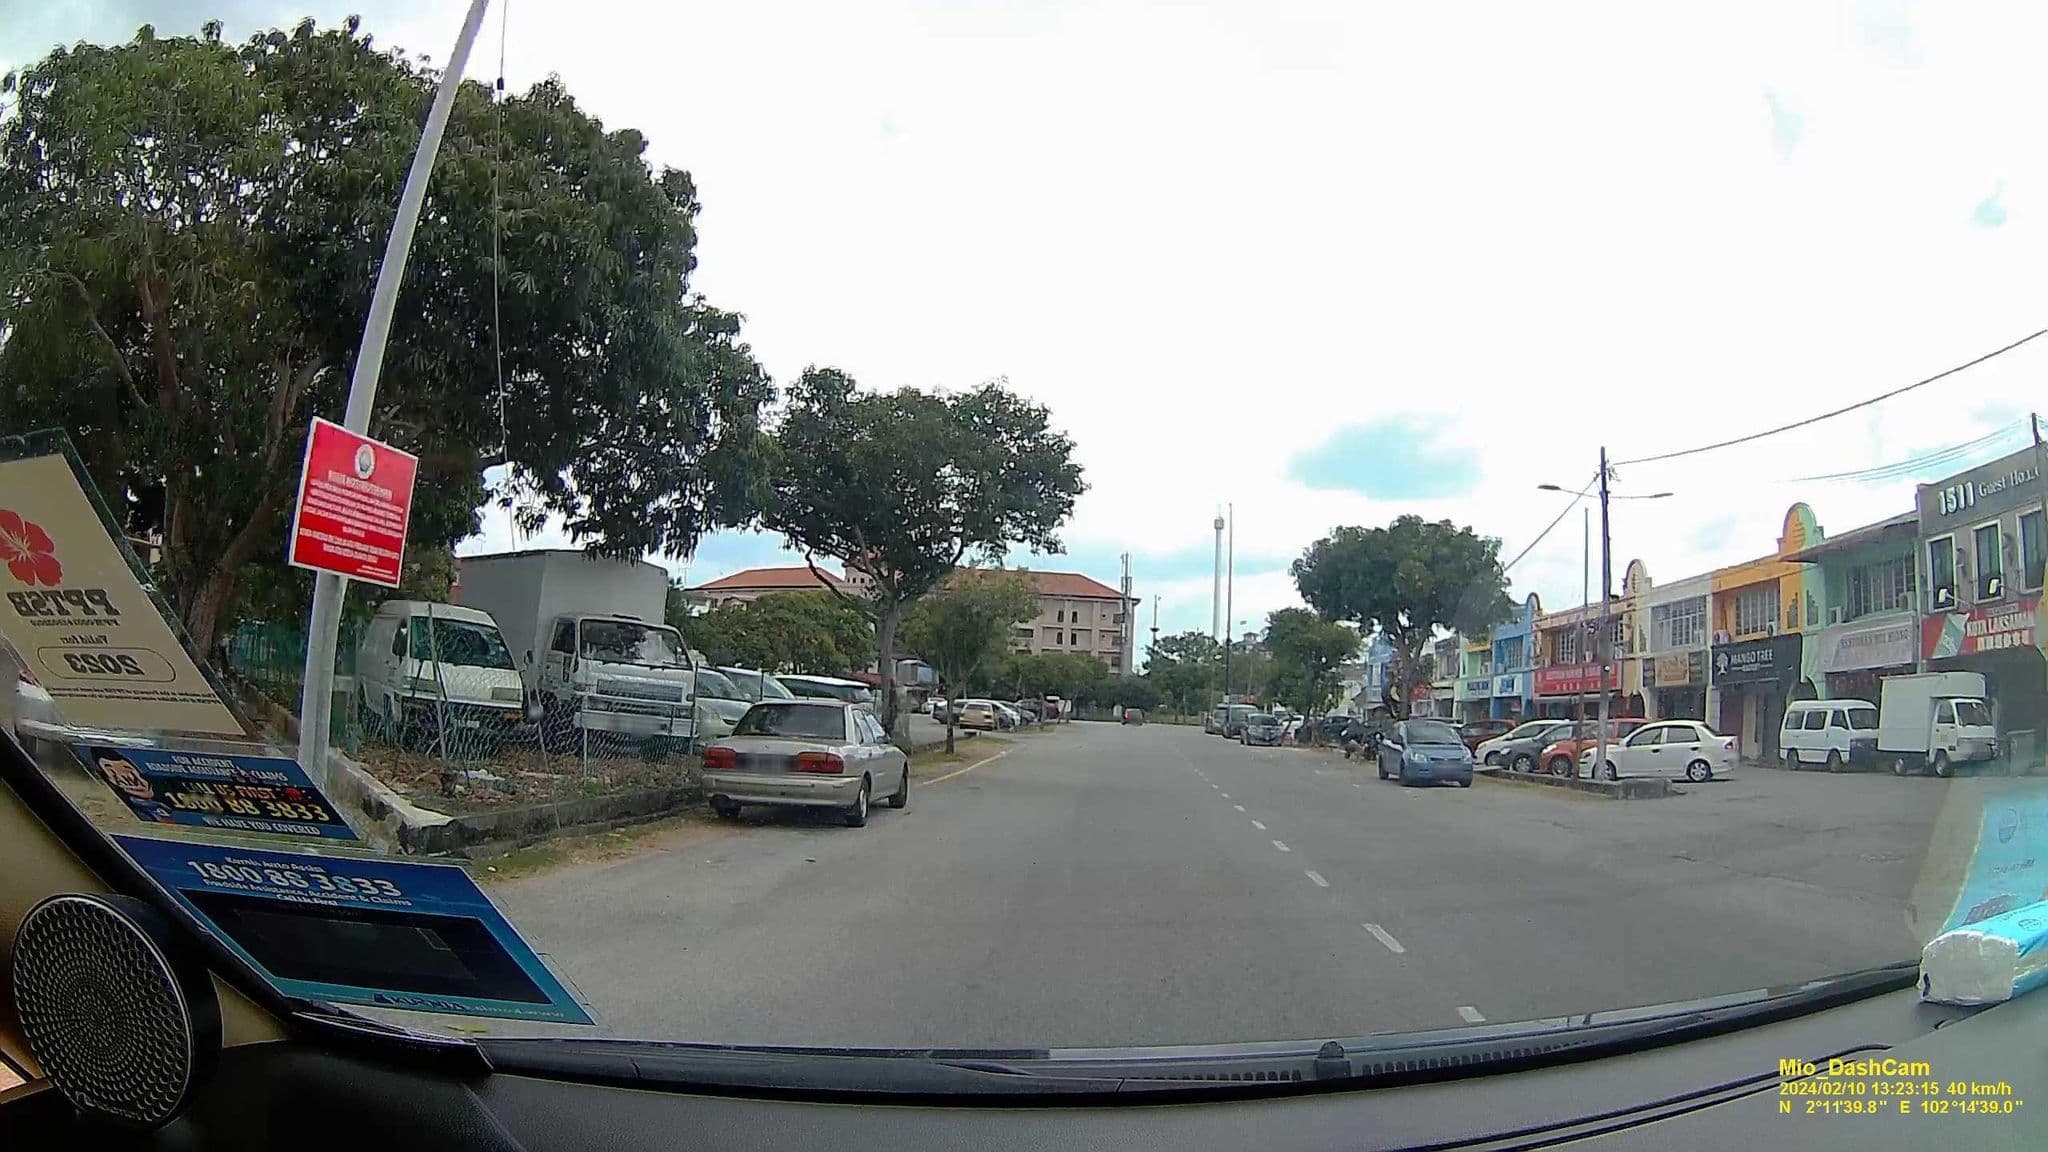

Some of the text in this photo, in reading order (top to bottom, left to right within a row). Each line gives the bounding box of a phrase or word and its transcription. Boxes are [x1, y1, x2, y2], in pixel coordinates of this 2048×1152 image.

[1979, 476, 2007, 498] Guest
[224, 799, 261, 815] 88
[265, 799, 330, 822] 3833
[221, 818, 251, 829] HAVE
[249, 820, 273, 832] YOU
[271, 823, 321, 836] COVERED
[187, 861, 402, 897] 1800 88 3833
